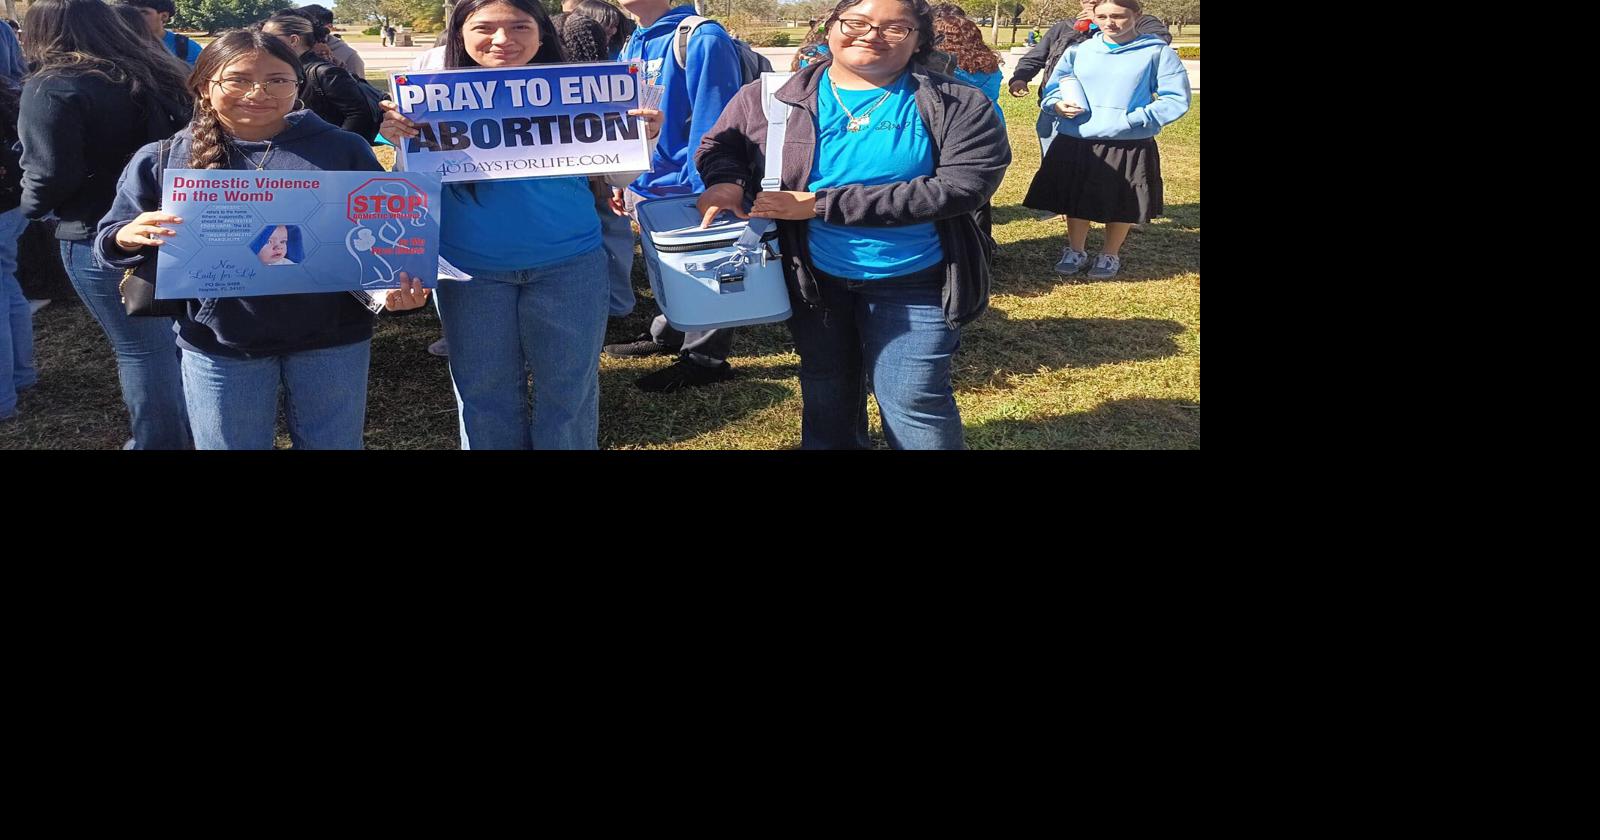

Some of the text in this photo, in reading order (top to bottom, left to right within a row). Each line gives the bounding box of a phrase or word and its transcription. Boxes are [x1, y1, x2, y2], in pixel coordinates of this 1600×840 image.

[400, 81, 498, 113] PRAY
[505, 78, 551, 108] TO
[560, 74, 635, 105] END
[408, 111, 640, 153] ABORTION
[173, 176, 320, 189] Domestic Violence
[172, 190, 274, 202] in the Womb
[353, 195, 423, 213] STOP
